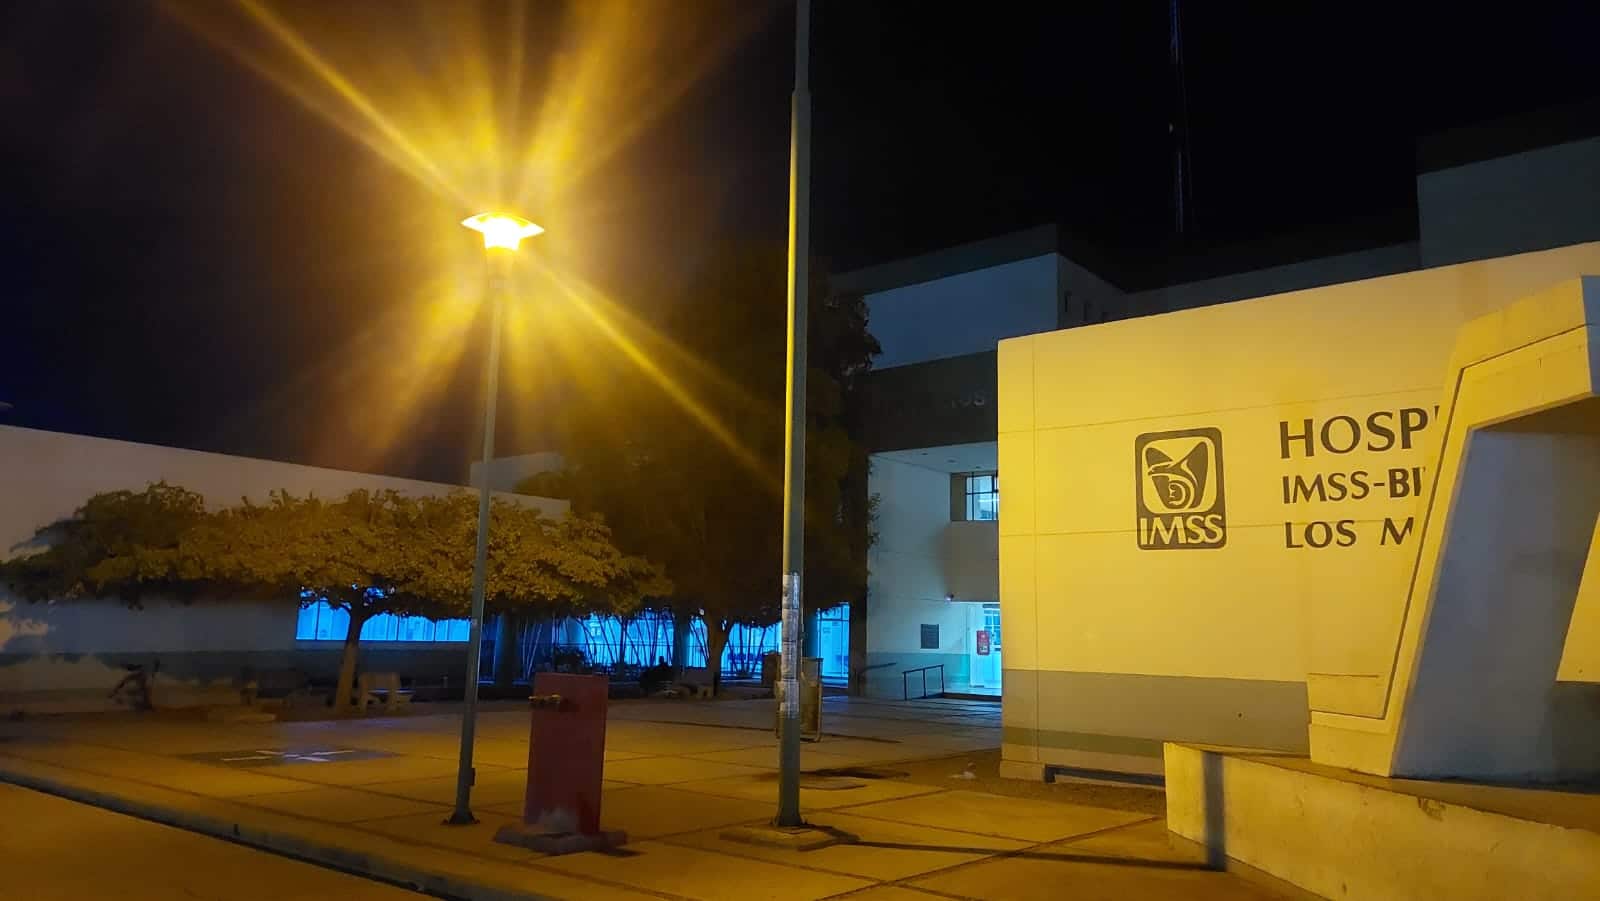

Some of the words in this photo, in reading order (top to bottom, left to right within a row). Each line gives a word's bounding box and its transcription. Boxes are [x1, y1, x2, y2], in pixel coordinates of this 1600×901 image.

[1282, 466, 1426, 504] IMSS-BI
[1140, 514, 1224, 545] IMSS
[1285, 519, 1356, 549] LOS
